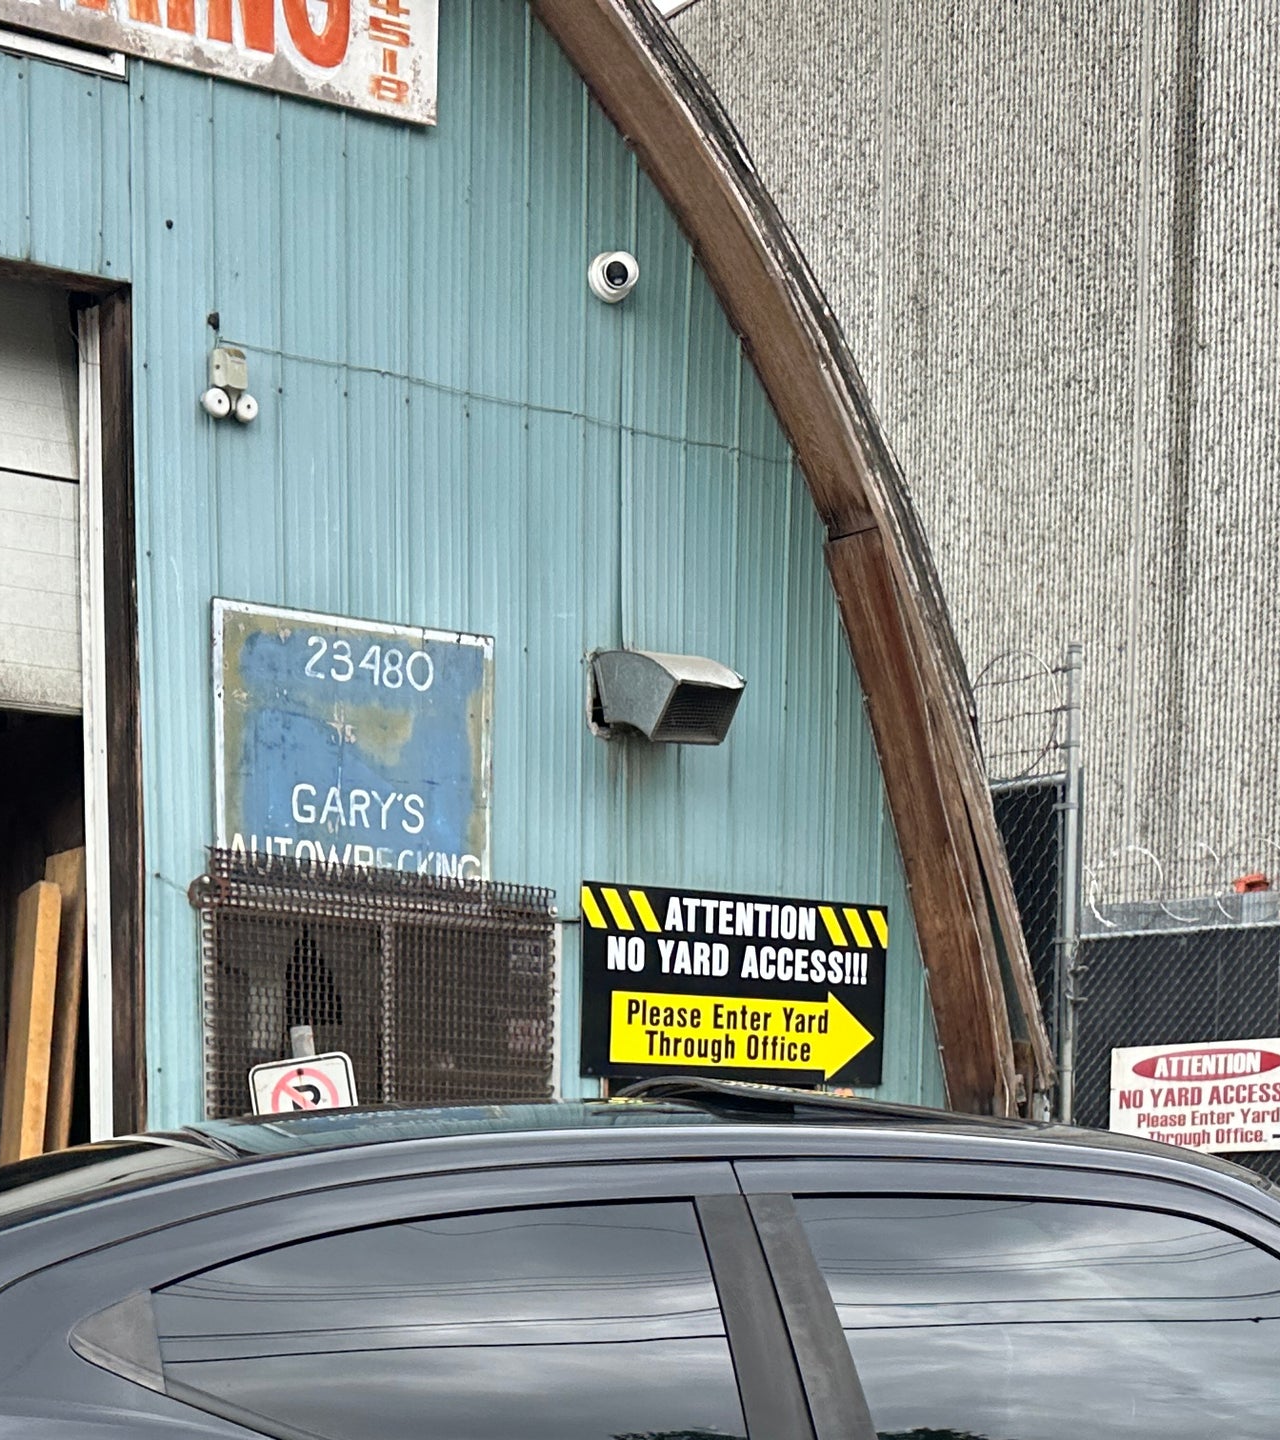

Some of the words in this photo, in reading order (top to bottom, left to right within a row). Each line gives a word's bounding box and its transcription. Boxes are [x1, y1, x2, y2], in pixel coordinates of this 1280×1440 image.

[305, 636, 434, 692] 23480
[292, 783, 425, 834] GARY'S
[664, 896, 816, 941] ATTENTION
[607, 936, 645, 972] NO
[657, 939, 729, 977] YARD
[740, 946, 868, 985] ACCESS!!!
[627, 999, 701, 1028] Please
[713, 1004, 772, 1032] Enter
[782, 1007, 829, 1034] Yard
[645, 1031, 735, 1064] Through
[746, 1034, 811, 1062] Office
[1154, 1051, 1261, 1078] ATTENTION
[1119, 1089, 1144, 1109] NO
[1150, 1086, 1202, 1108] YARD
[1137, 1112, 1186, 1128] Please
[1191, 1109, 1235, 1126] Enter
[1240, 1107, 1280, 1124] Yard
[1148, 1129, 1211, 1147] Through
